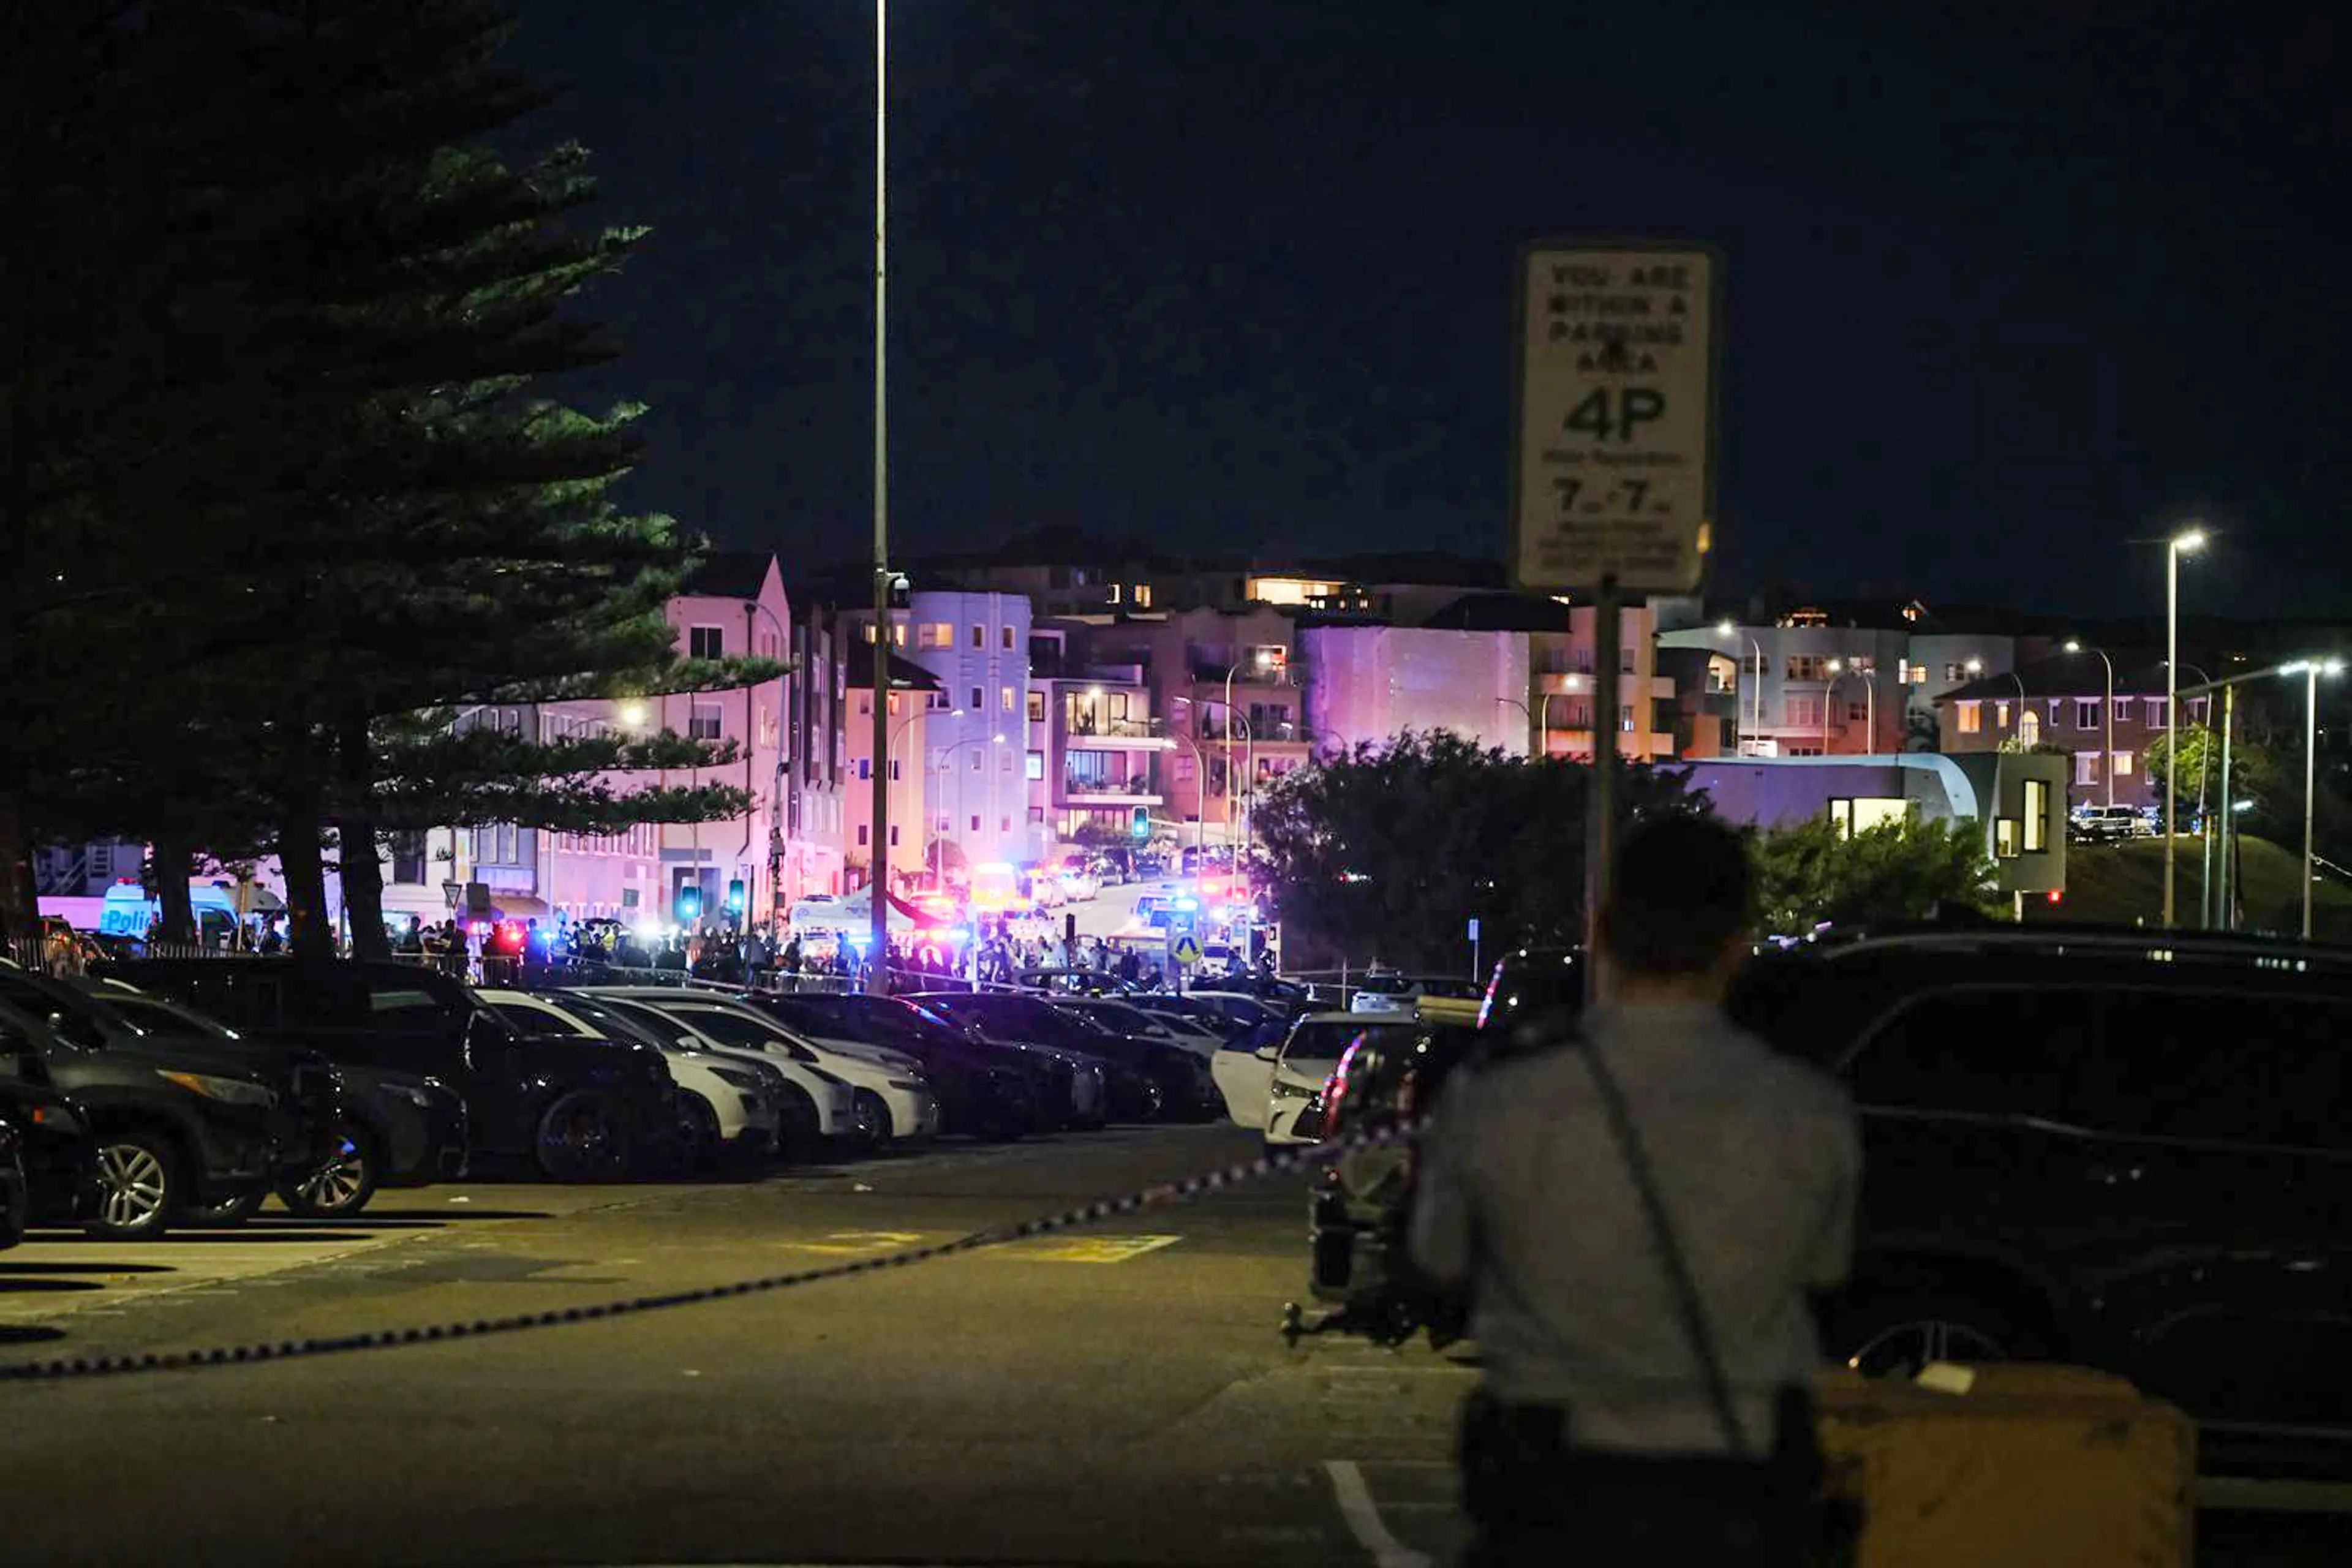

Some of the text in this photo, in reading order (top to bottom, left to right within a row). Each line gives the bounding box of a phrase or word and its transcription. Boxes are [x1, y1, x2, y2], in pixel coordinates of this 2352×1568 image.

[1551, 264, 1689, 290] YOU ARE
[1562, 386, 1665, 440] 4P
